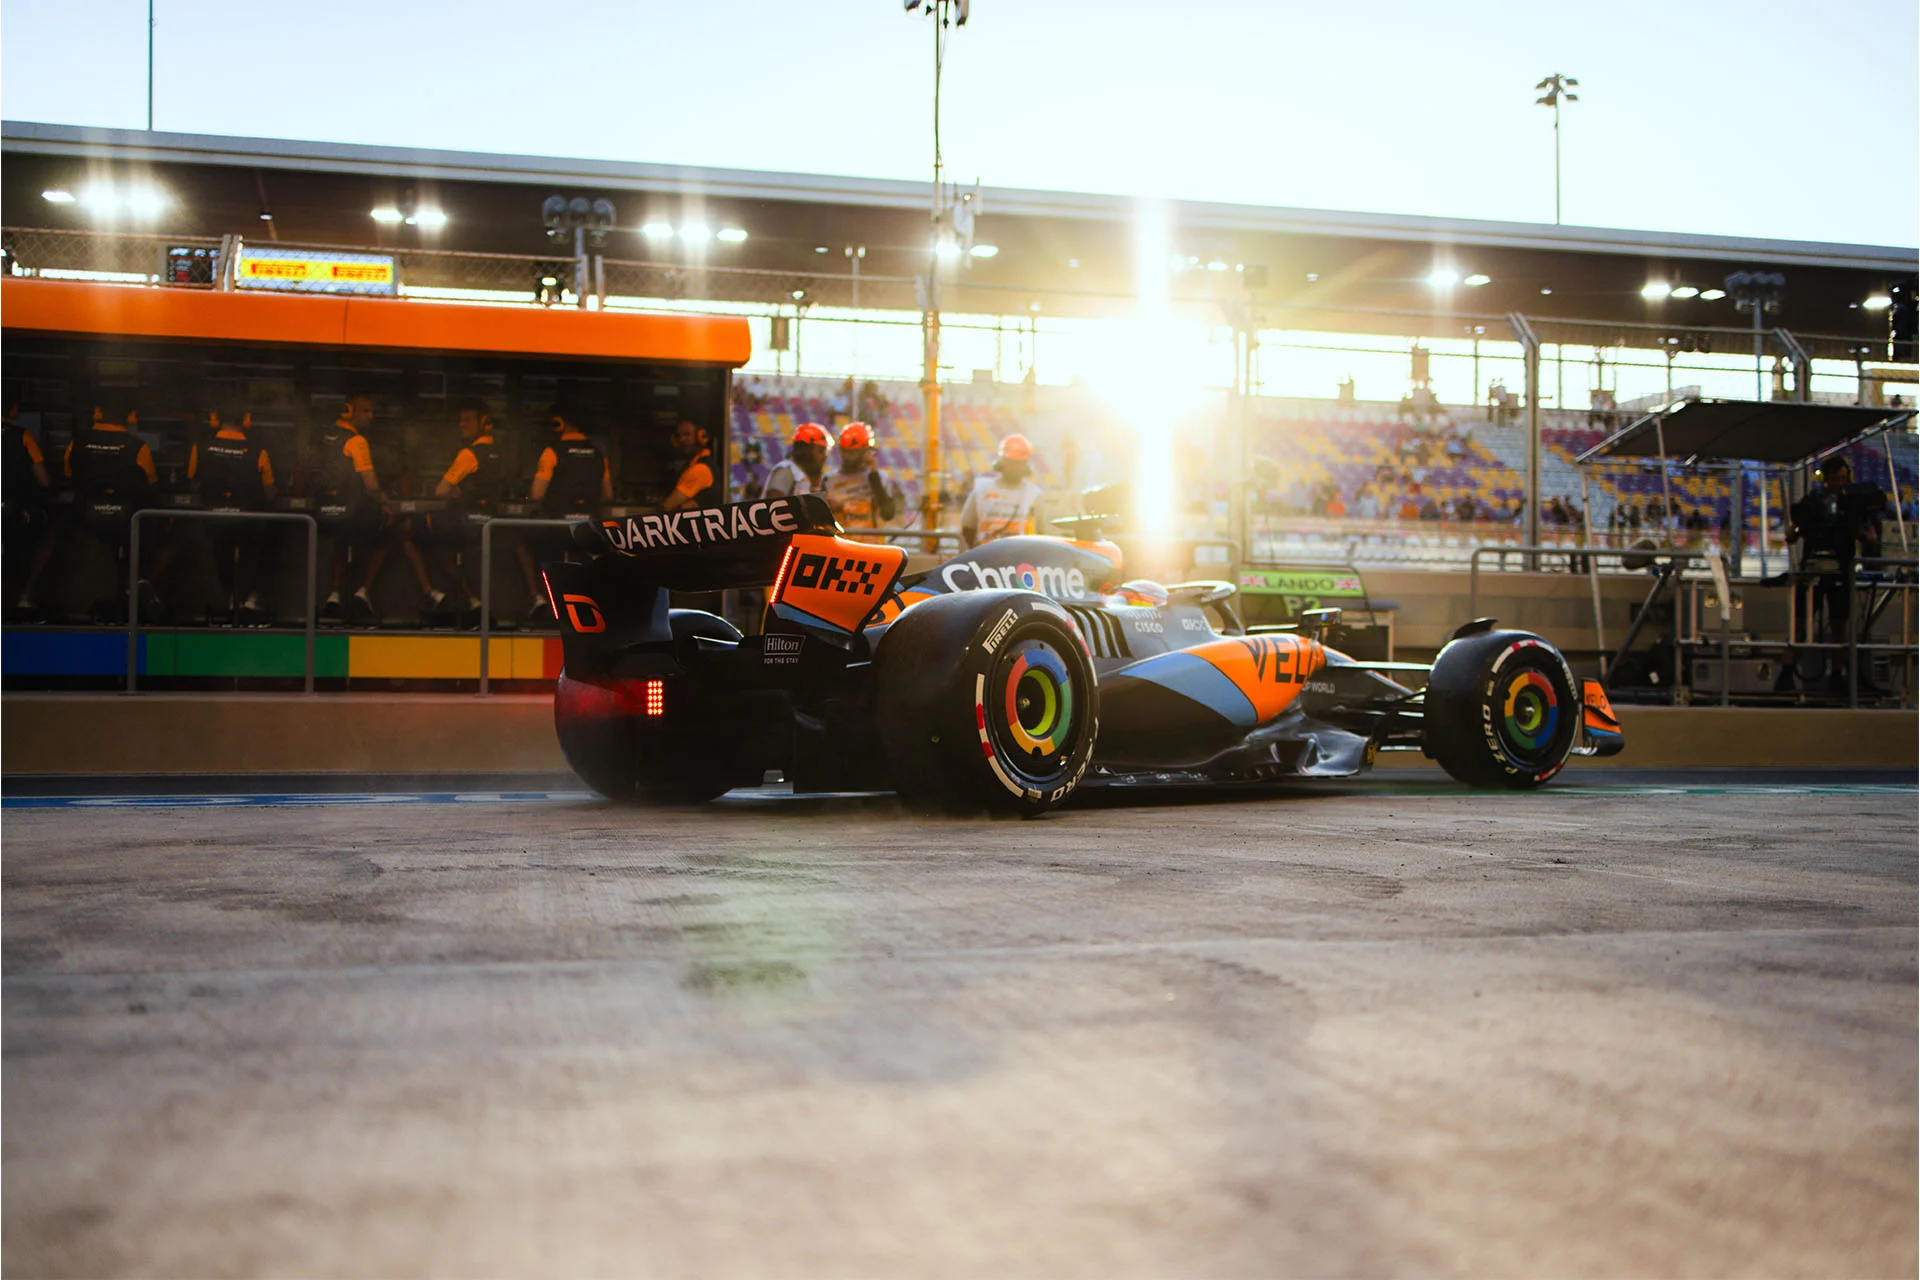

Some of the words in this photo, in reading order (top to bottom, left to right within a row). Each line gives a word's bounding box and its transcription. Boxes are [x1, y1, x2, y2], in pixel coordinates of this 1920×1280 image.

[602, 500, 799, 550] DARKTRACE
[791, 553, 883, 596] OKX
[941, 561, 1085, 600] Chrome
[1264, 576, 1335, 591] LANDO
[767, 637, 799, 651] Hilton
[982, 608, 1019, 655] PIRELLI
[1312, 682, 1336, 694] WORLD
[1483, 703, 1506, 764] ZERO
